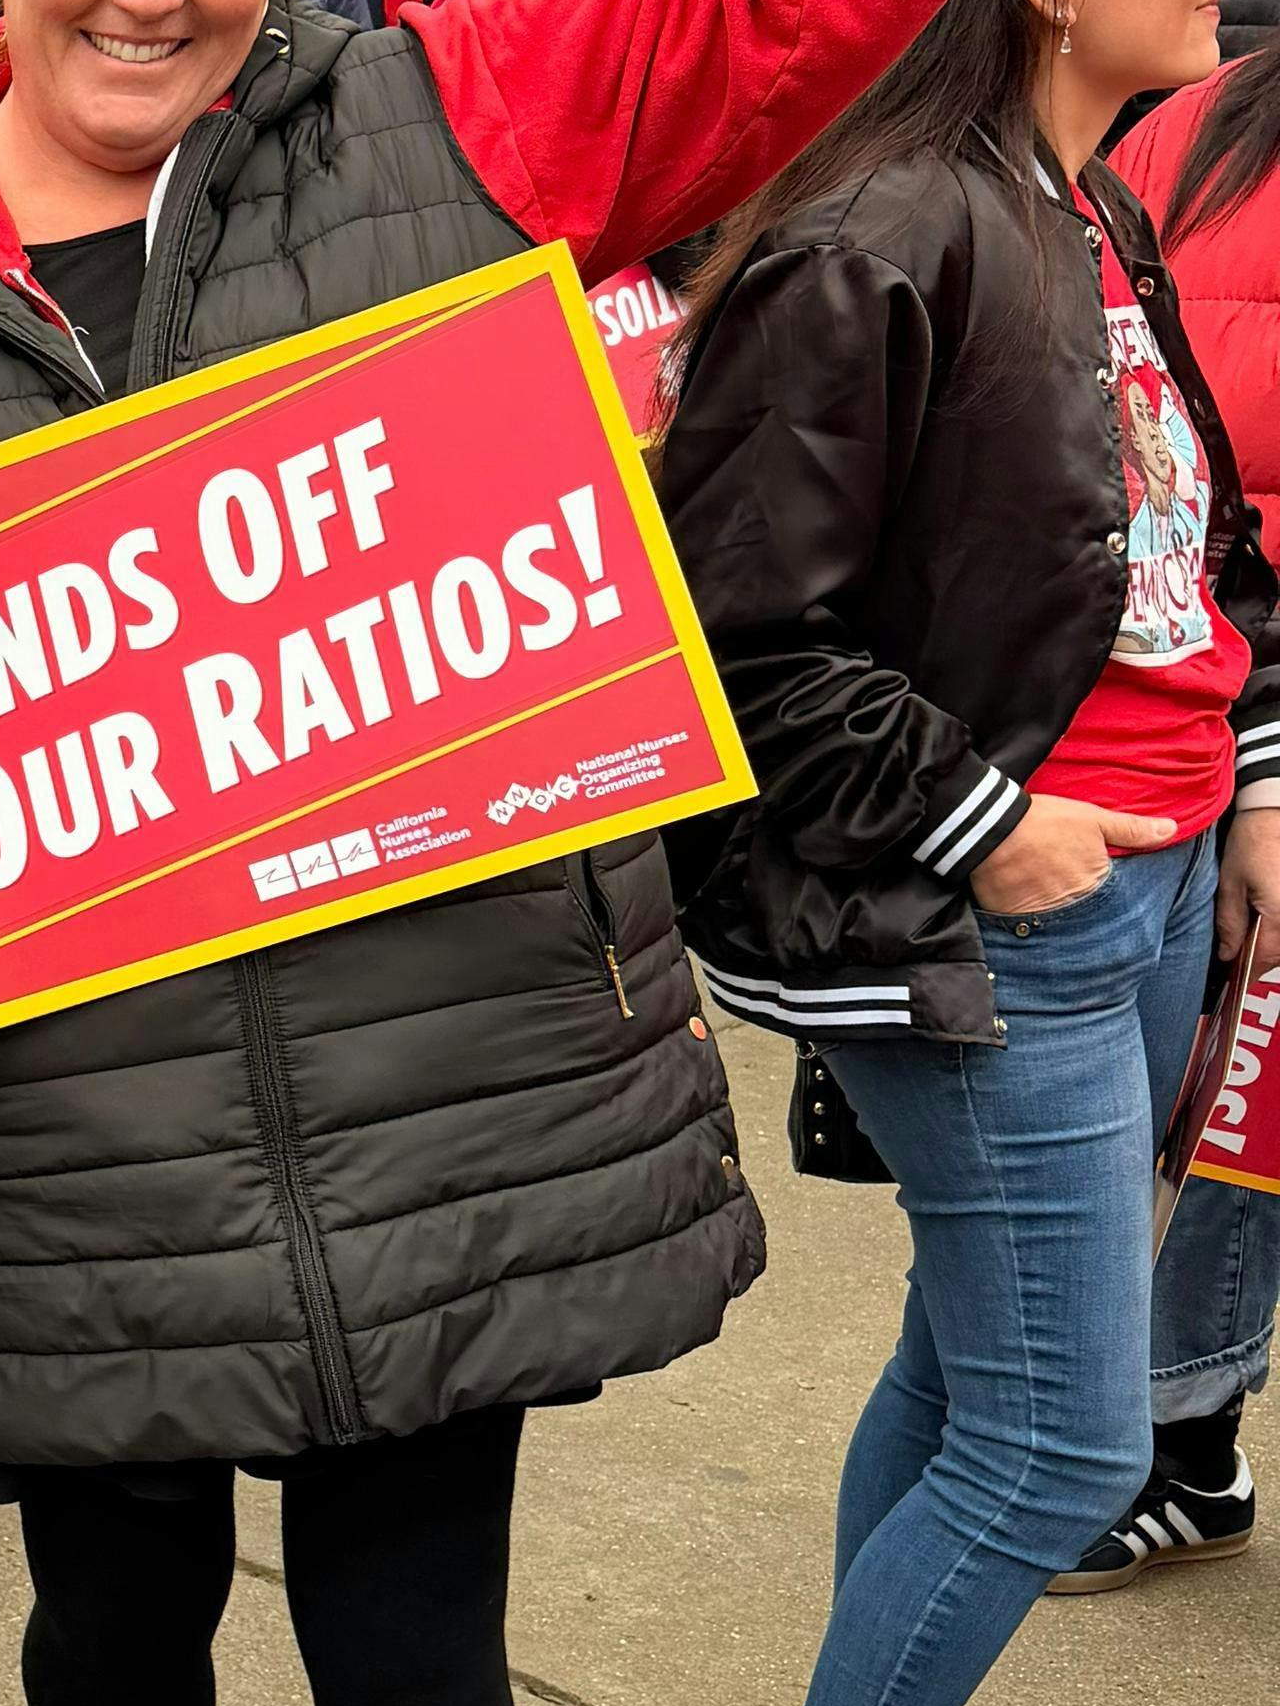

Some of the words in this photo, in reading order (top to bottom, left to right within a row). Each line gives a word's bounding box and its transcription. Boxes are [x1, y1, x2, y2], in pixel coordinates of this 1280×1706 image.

[196, 416, 395, 603] OFF
[182, 483, 624, 792] RATIOS!
[575, 746, 639, 775] National
[638, 729, 689, 756] Nurses
[580, 753, 661, 788] Organizing
[584, 766, 666, 799] Committee
[375, 805, 448, 837] California
[379, 825, 432, 850] Nurses
[384, 826, 472, 863] Association
